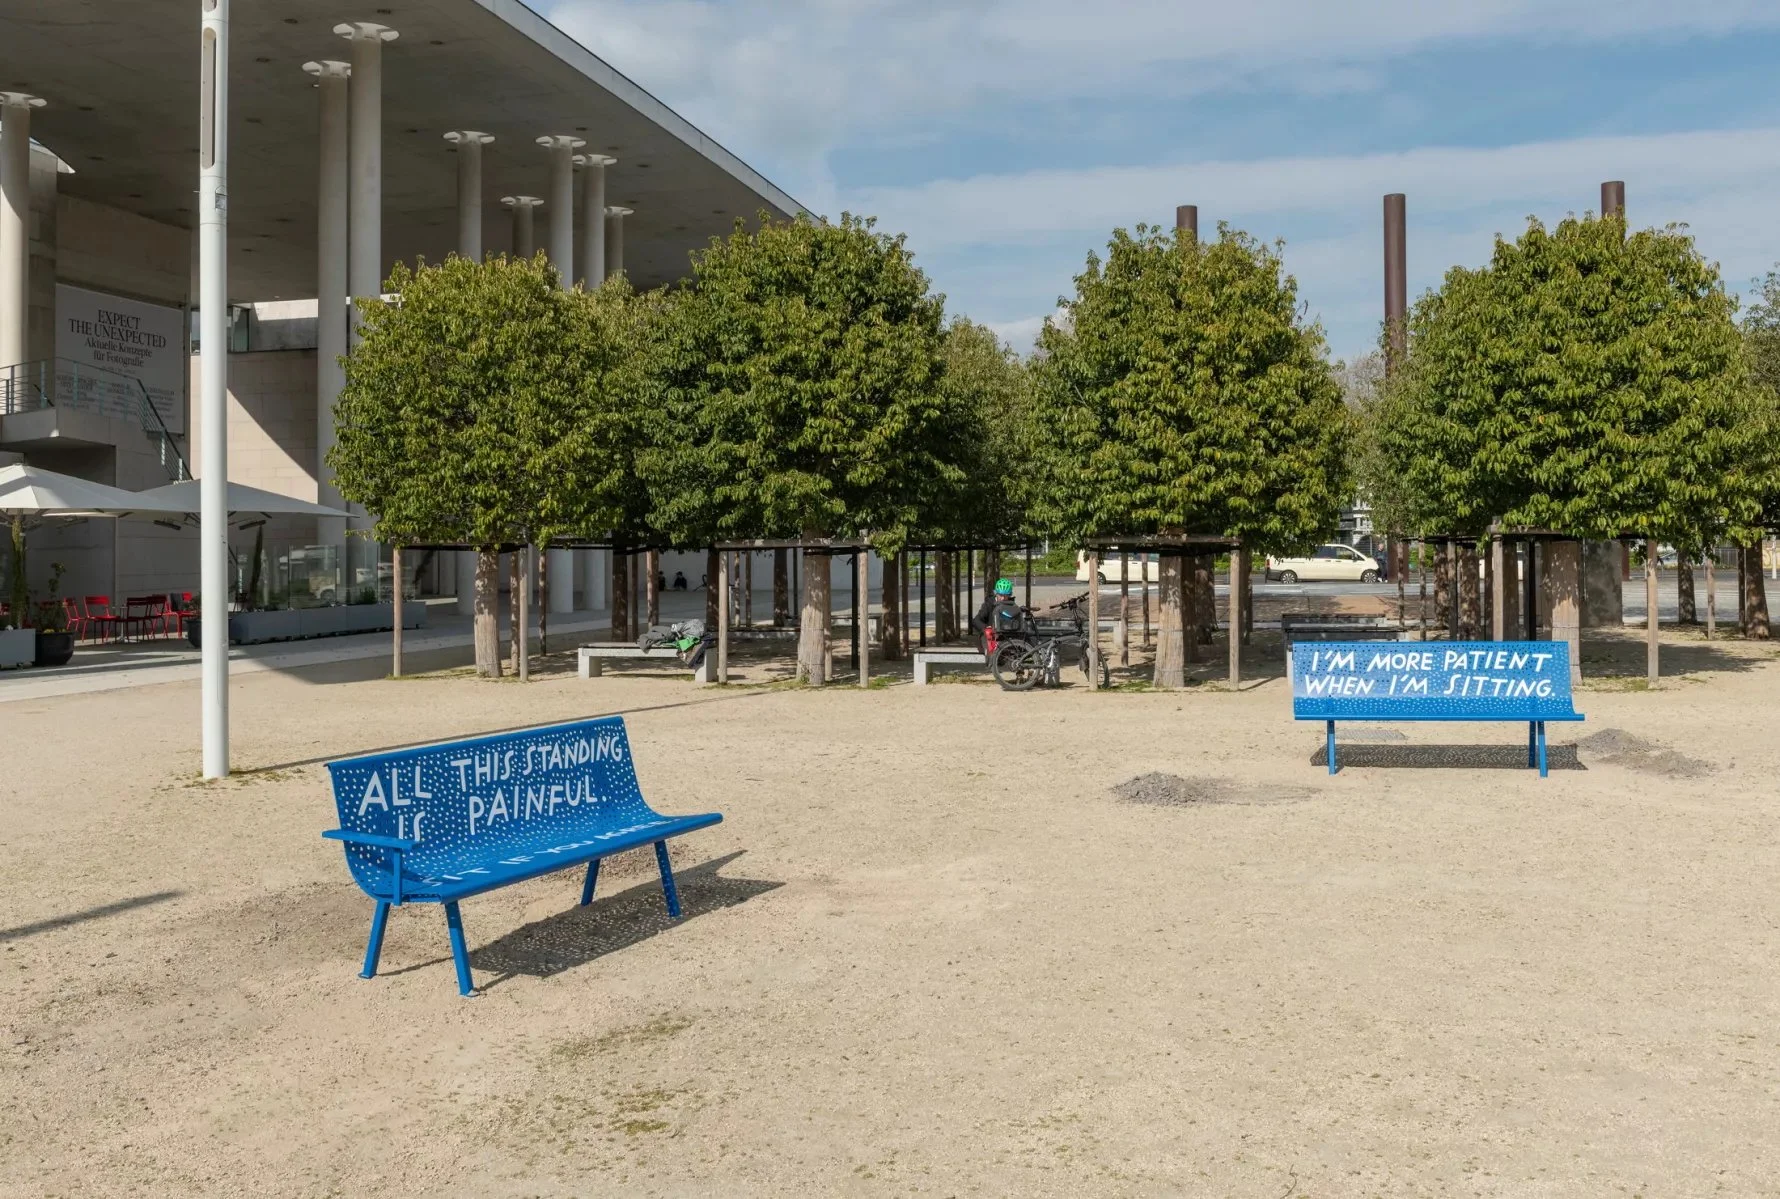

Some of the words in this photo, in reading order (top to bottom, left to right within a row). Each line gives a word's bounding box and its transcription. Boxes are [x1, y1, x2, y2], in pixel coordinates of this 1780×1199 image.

[98, 309, 141, 330] EXPECT
[68, 318, 92, 336] THE
[94, 324, 167, 349] UNEXPECTED
[85, 338, 118, 353] Aktuelle
[119, 342, 153, 359] Konzepte
[93, 350, 106, 362] für
[106, 352, 145, 368] Fotografie
[1311, 651, 1355, 672] I'M
[1367, 652, 1433, 672] MORE
[1444, 650, 1553, 672] PATIENT
[1303, 674, 1375, 696] WHEN
[1388, 673, 1429, 695] I'M
[1443, 673, 1557, 698] SITTING.
[357, 765, 433, 816] ALL
[449, 750, 515, 793] THIS
[522, 735, 623, 776] STANDING
[398, 810, 426, 842] IS
[422, 866, 492, 887] SIT
[497, 855, 536, 865] IF
[533, 840, 595, 854] YOU
